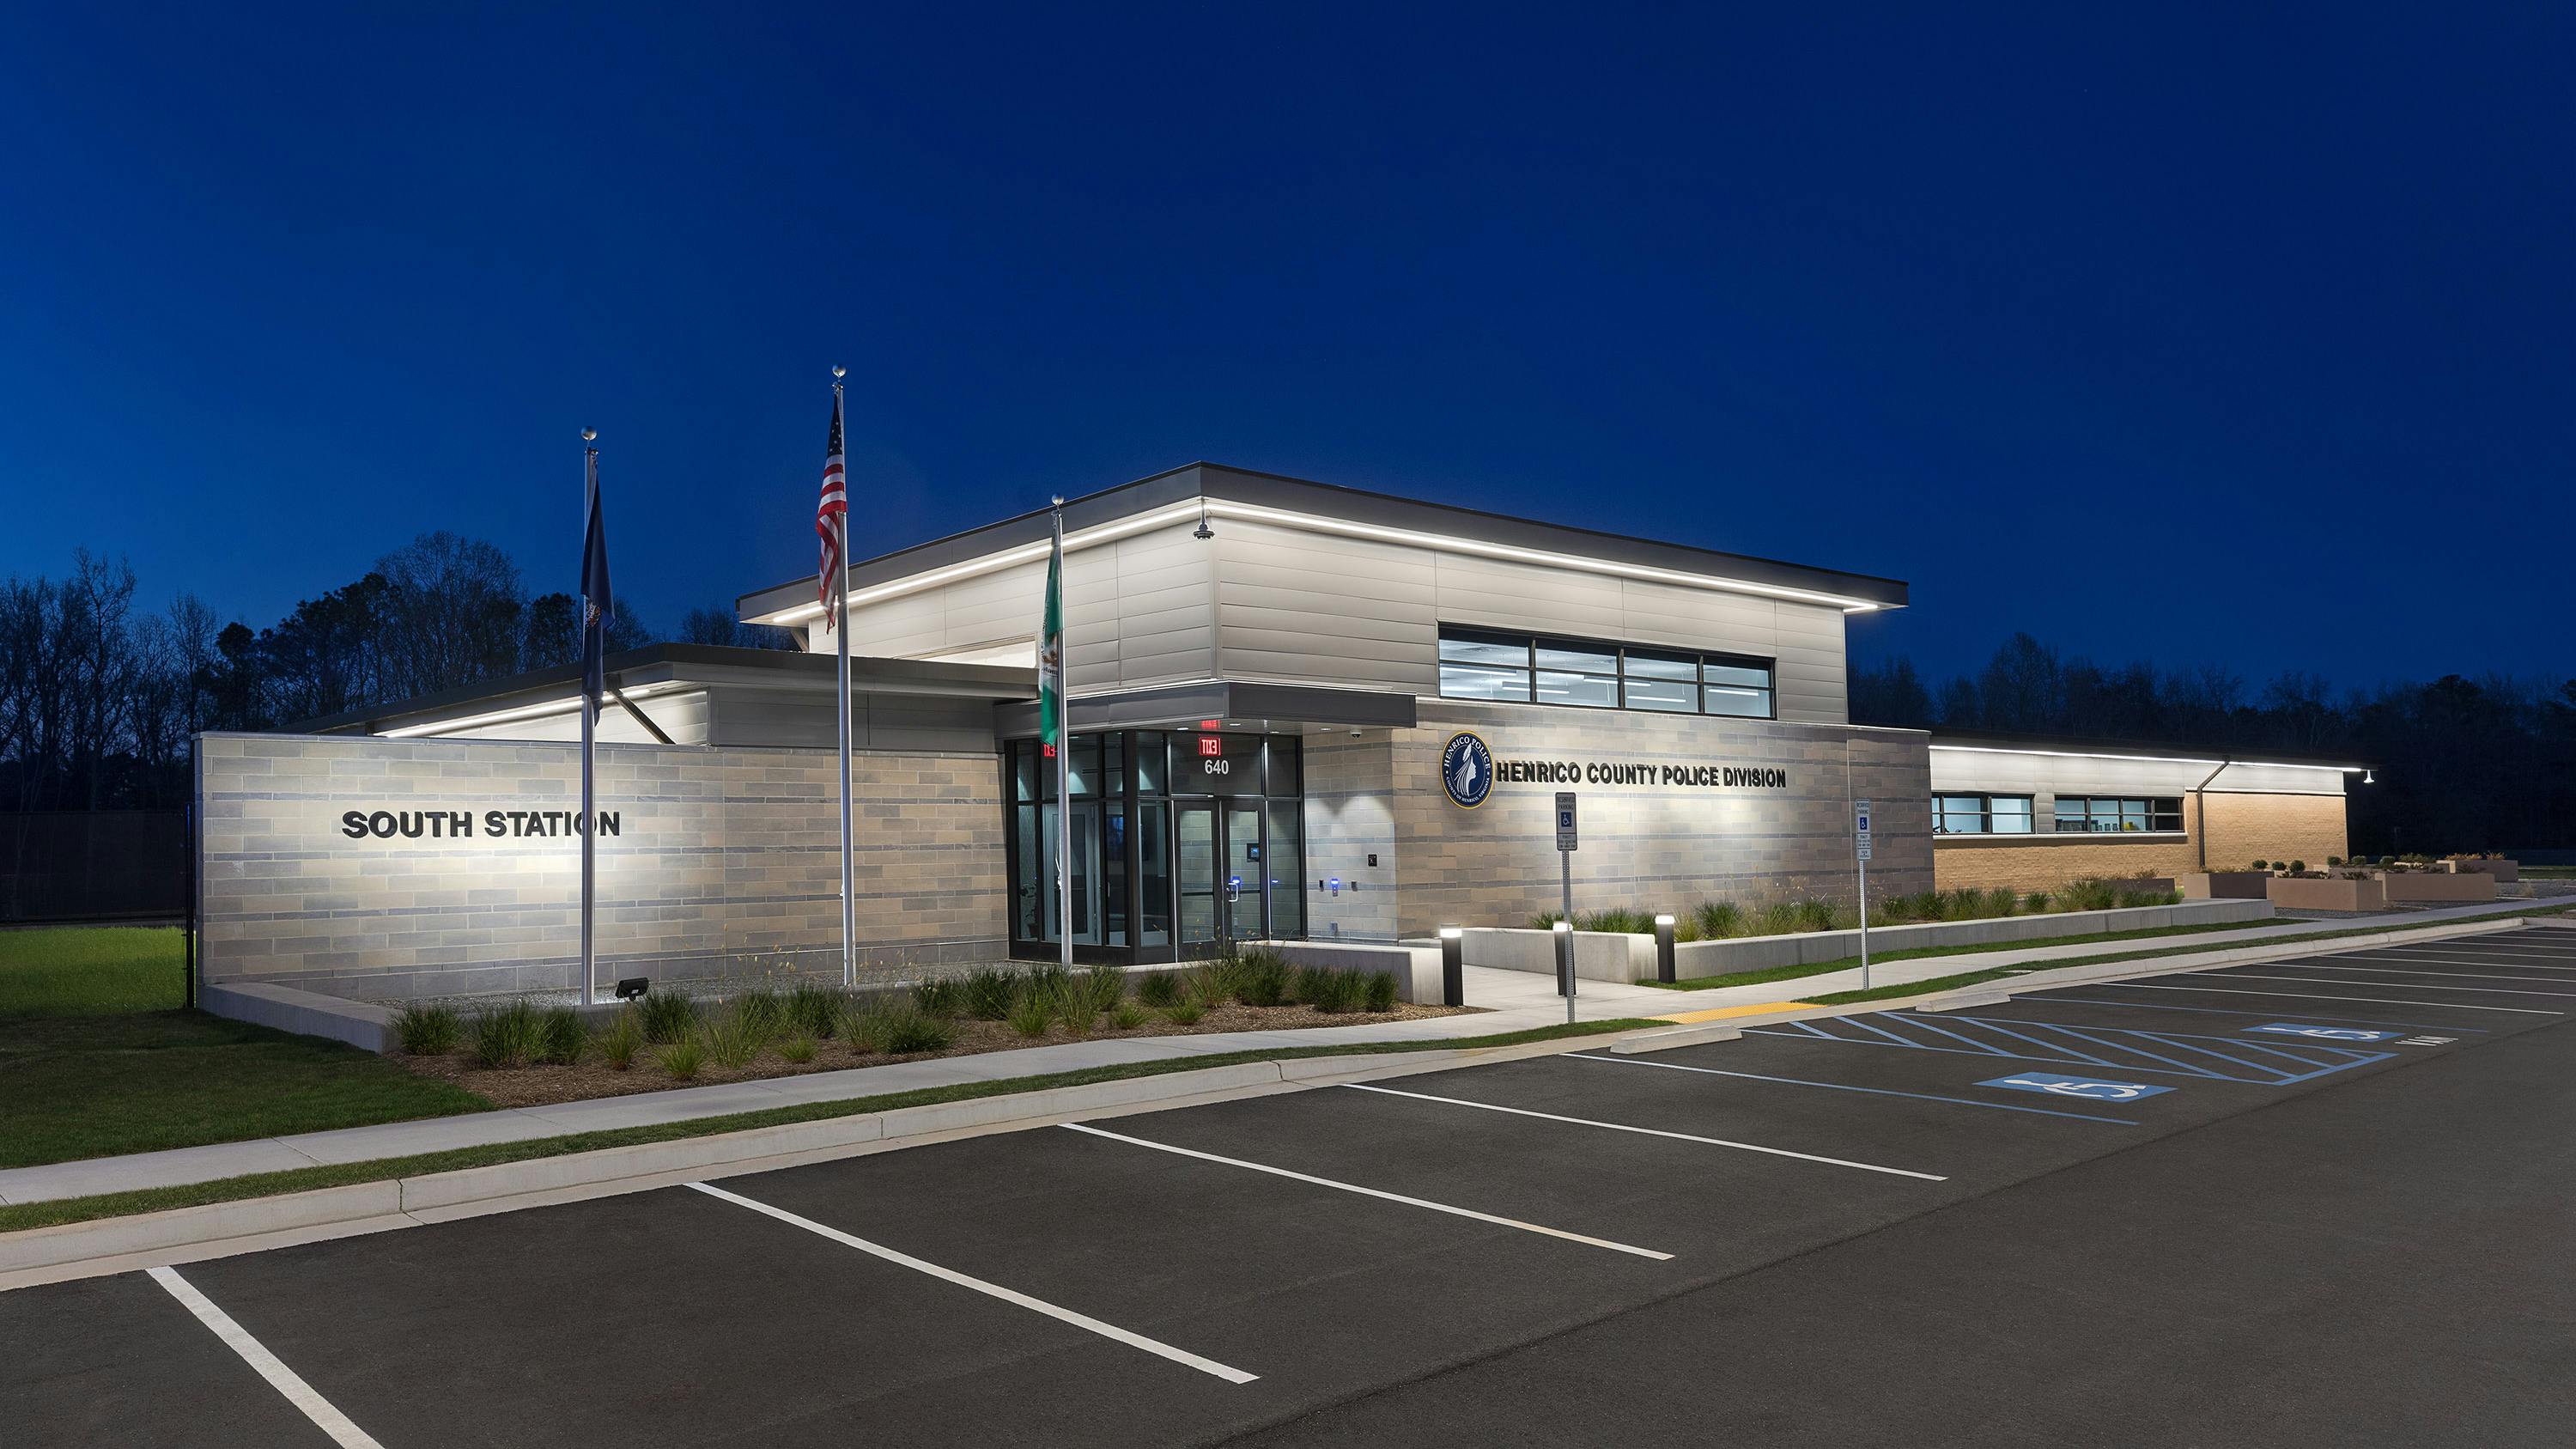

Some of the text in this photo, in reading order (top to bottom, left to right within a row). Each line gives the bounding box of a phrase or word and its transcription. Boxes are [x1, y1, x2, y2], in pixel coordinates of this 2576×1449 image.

[1444, 736, 1491, 769] HENRICO POLICE
[1205, 759, 1229, 774] 640
[1495, 760, 1787, 788] HENRICO COUNTY POLICE DIVISION
[342, 811, 472, 838] SOUTH
